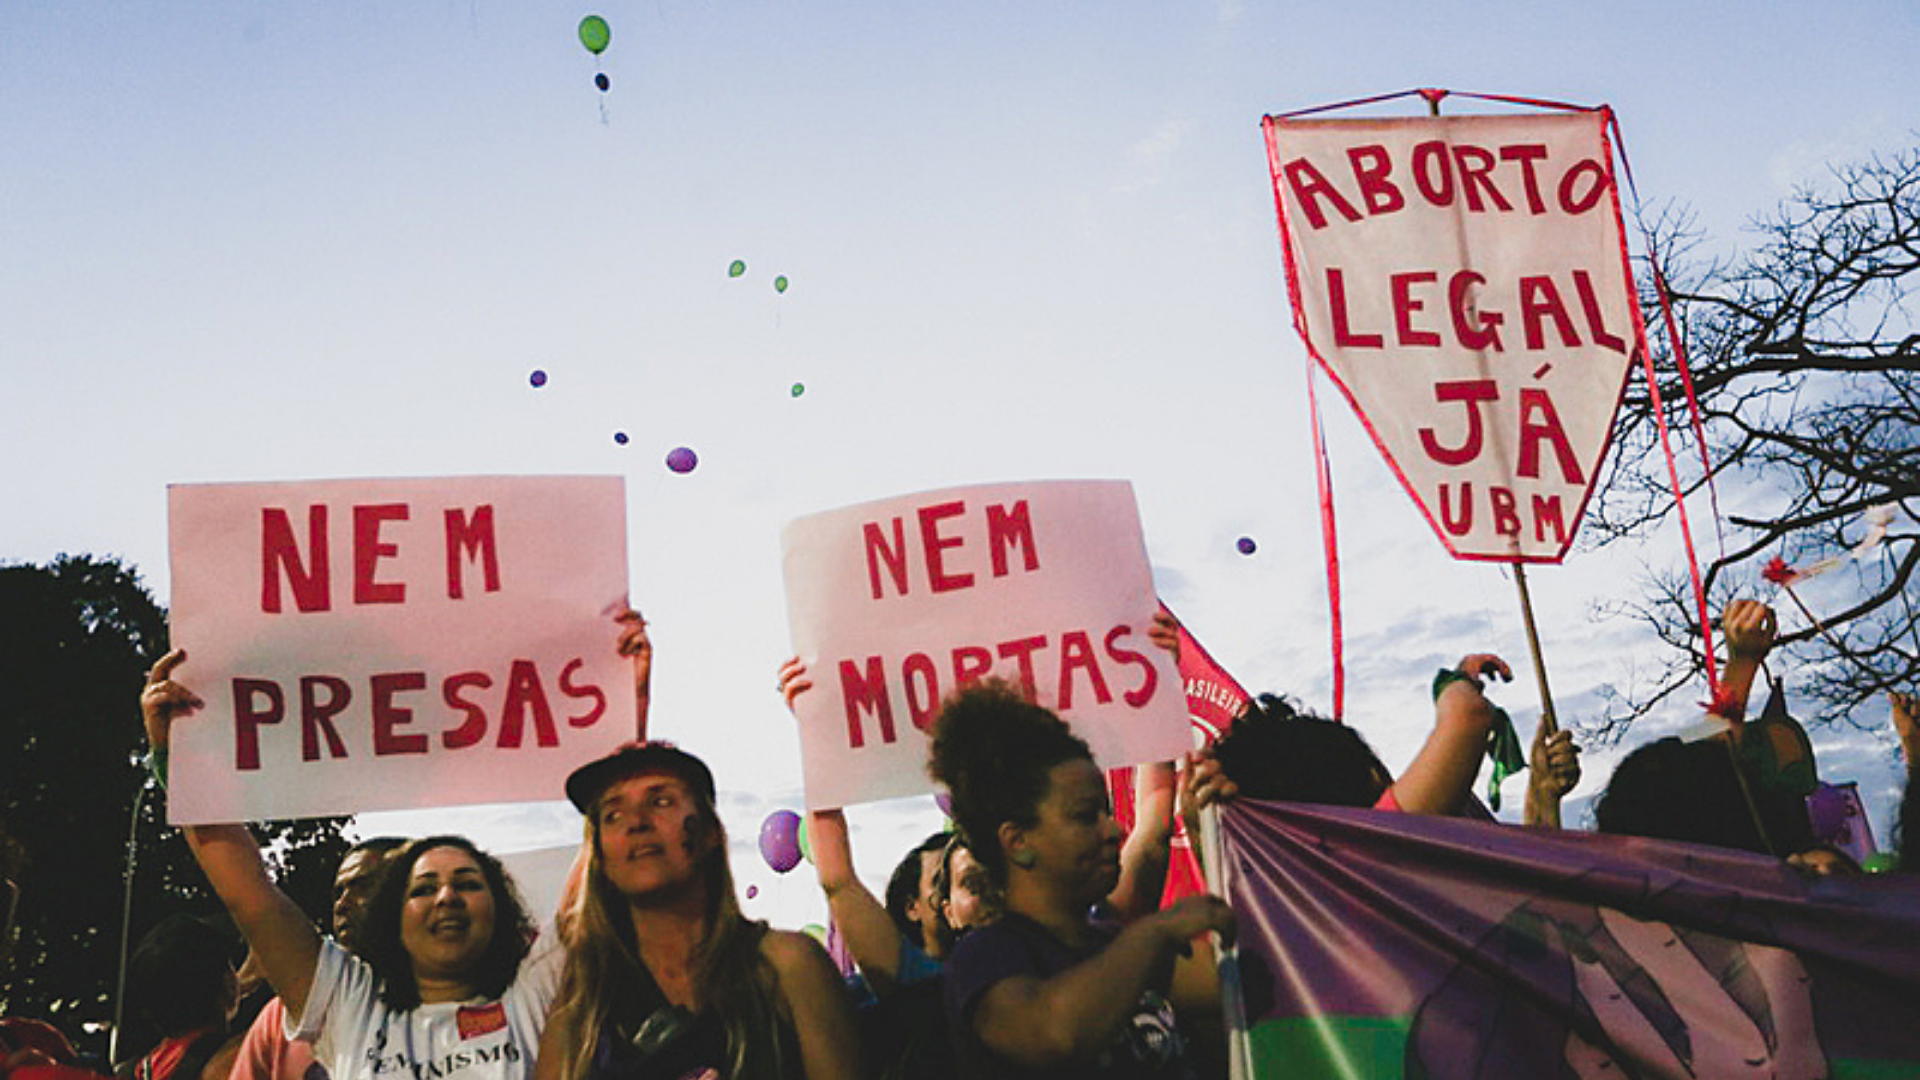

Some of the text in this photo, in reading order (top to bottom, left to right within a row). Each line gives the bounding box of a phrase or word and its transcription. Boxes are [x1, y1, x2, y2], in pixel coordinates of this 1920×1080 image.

[1283, 140, 1612, 230] ABORTO
[1325, 268, 1627, 354] LEGAL
[1418, 363, 1586, 486] JÁ
[260, 503, 501, 614] NEM
[862, 499, 1040, 601] NEM
[1438, 482, 1567, 545] UBM
[231, 656, 609, 771] PRESAS
